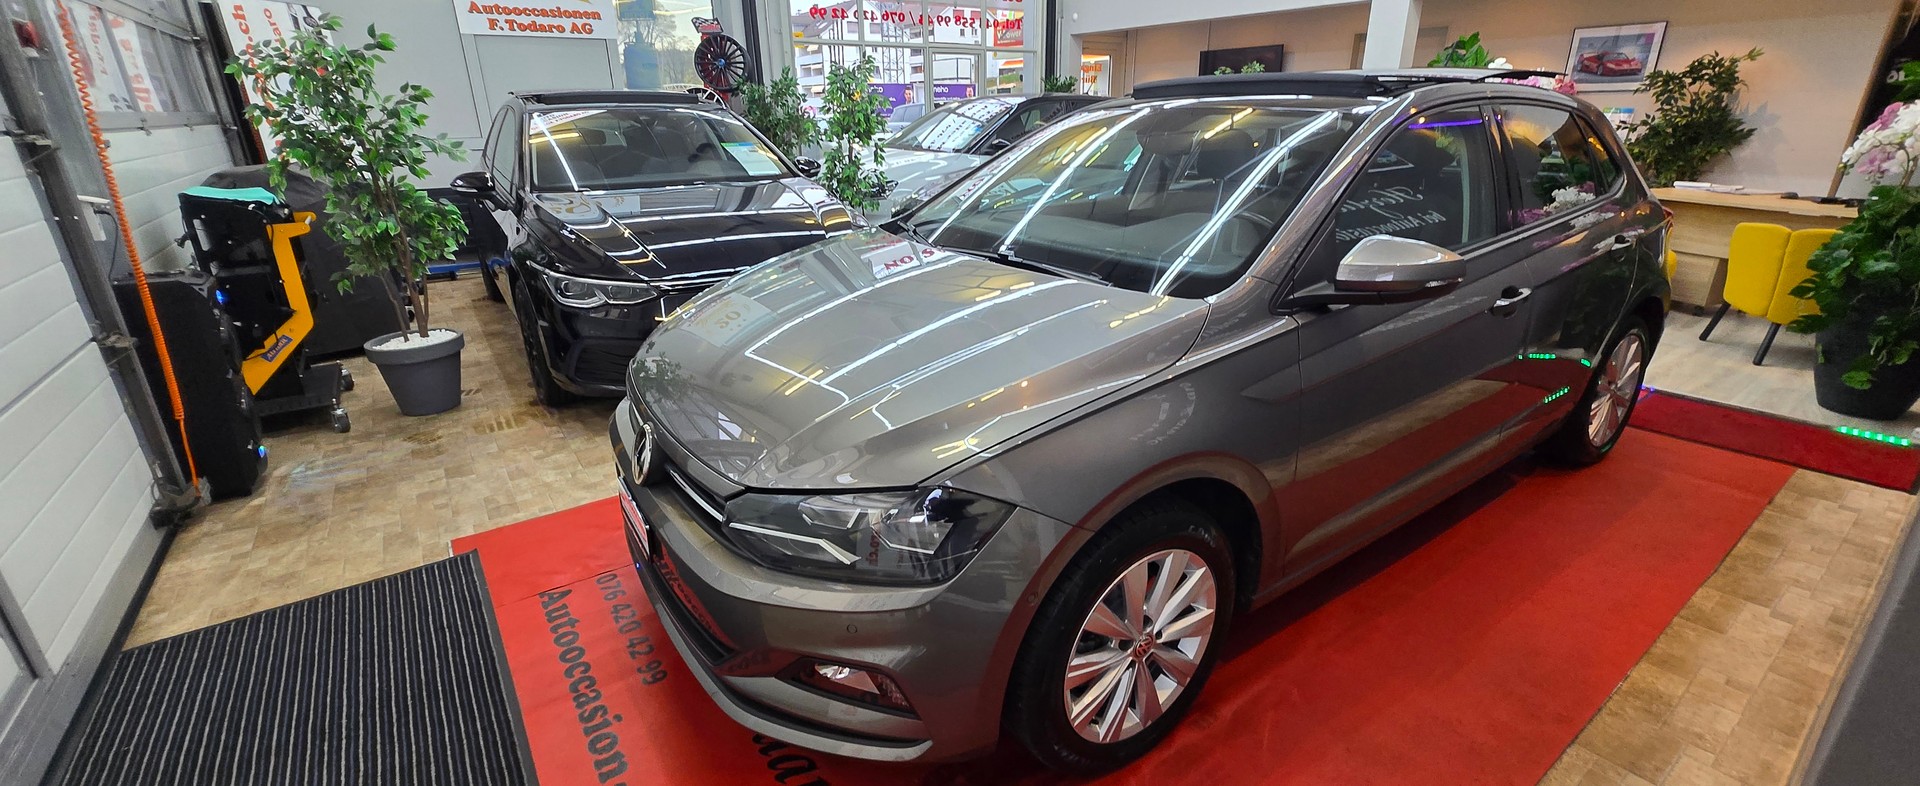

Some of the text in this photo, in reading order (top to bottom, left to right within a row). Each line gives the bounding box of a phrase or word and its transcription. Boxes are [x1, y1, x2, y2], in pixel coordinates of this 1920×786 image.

[468, 1, 602, 20] Autooccasionen
[486, 18, 594, 35] F. Todaro AG
[596, 573, 668, 686] 076 420 42 99
[538, 588, 629, 786] Autooccasion
